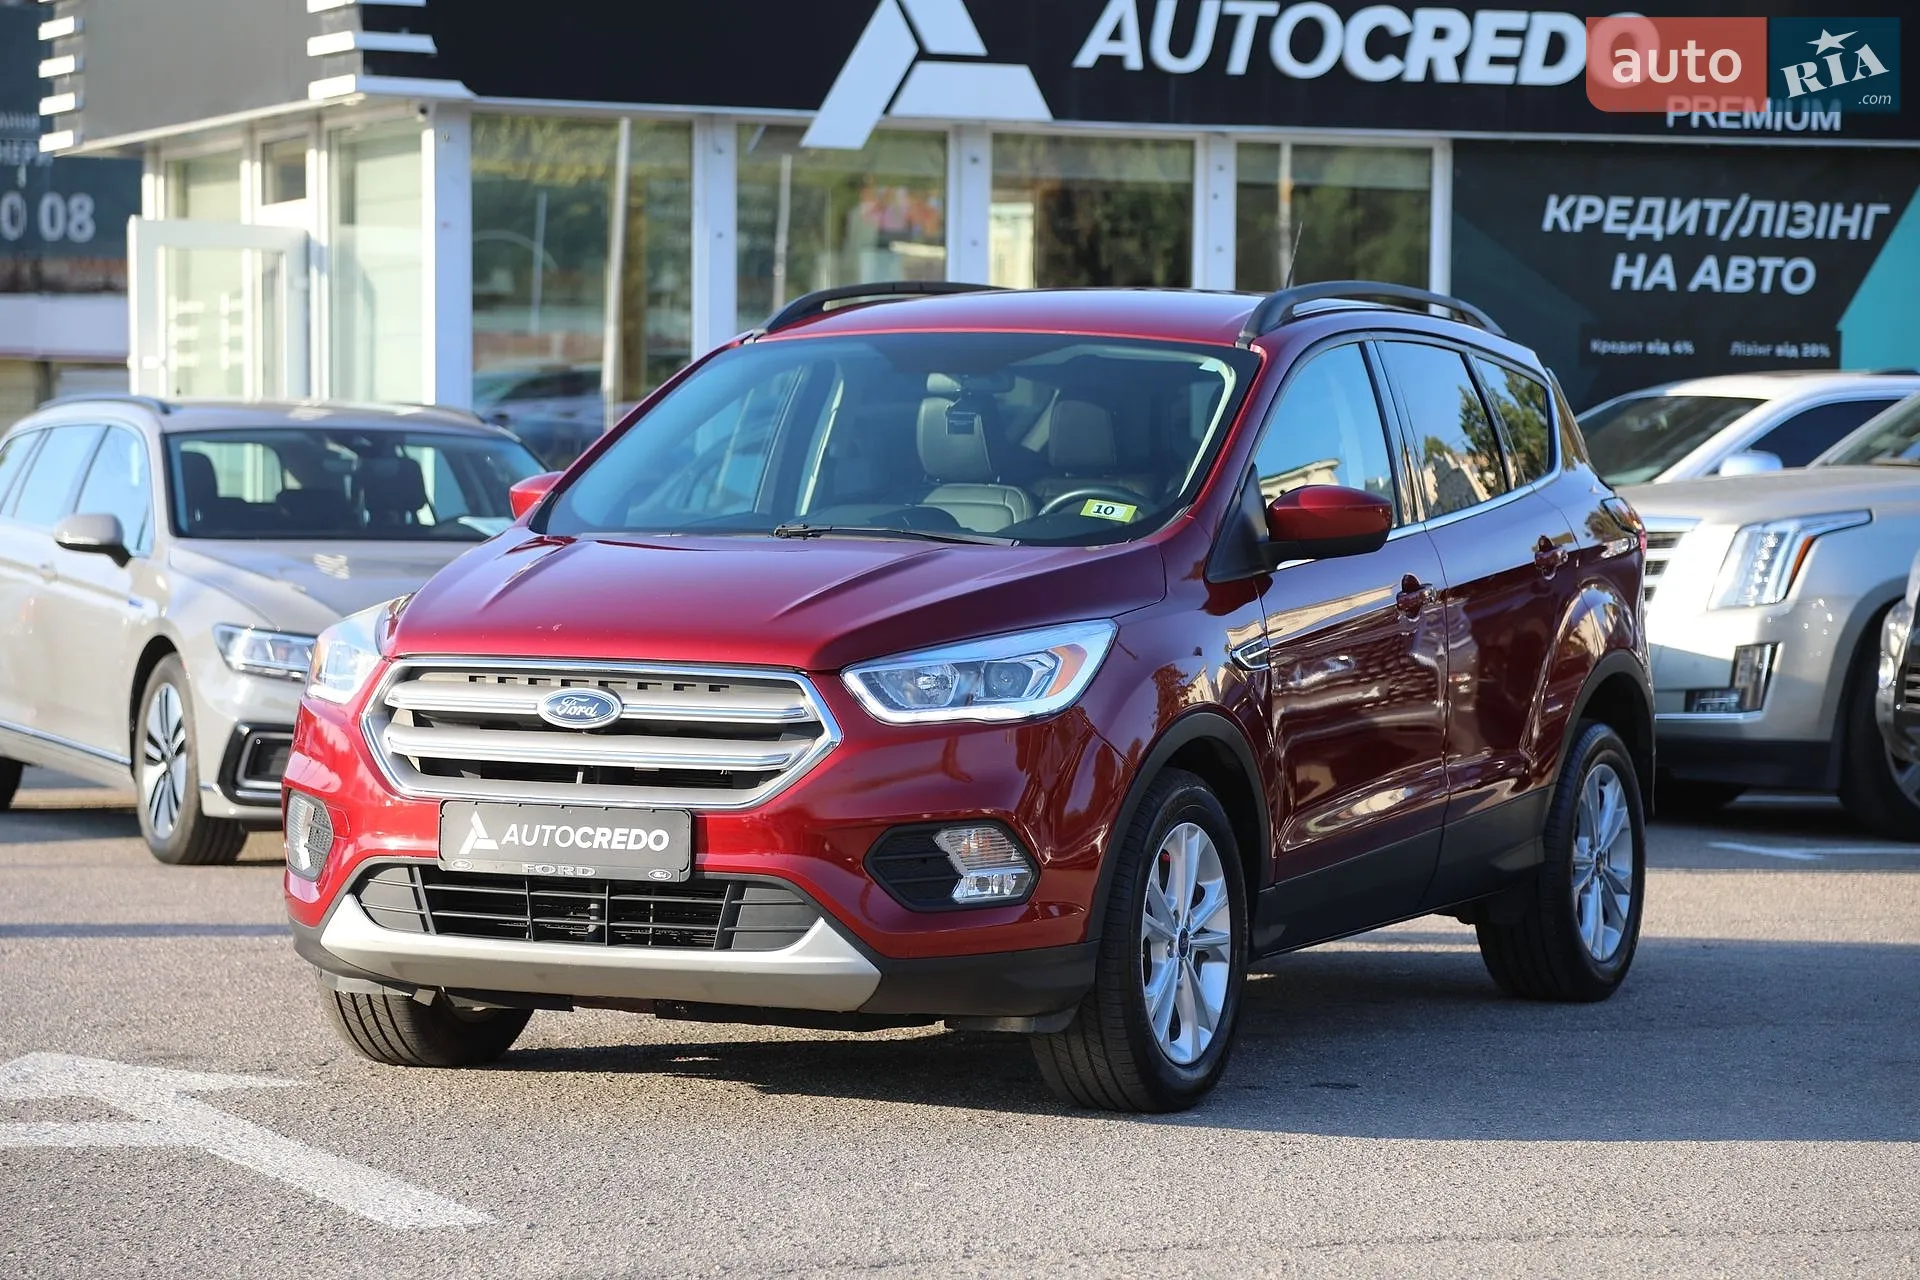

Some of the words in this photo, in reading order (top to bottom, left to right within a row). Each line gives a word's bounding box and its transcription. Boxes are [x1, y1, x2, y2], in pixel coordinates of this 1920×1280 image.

[1071, 0, 1661, 89] AUTOCREDO
[1666, 95, 1842, 132] PREMIUM
[38, 191, 96, 243] 08
[1542, 193, 1891, 241] КРЕДИТ/ЛІЗІНГ
[1610, 252, 1677, 292] НА
[1687, 254, 1817, 295] АВТО
[1093, 504, 1115, 515] 10
[556, 696, 599, 717] Ford
[501, 823, 670, 852] AUTOCREDO
[521, 864, 596, 877] FORD
